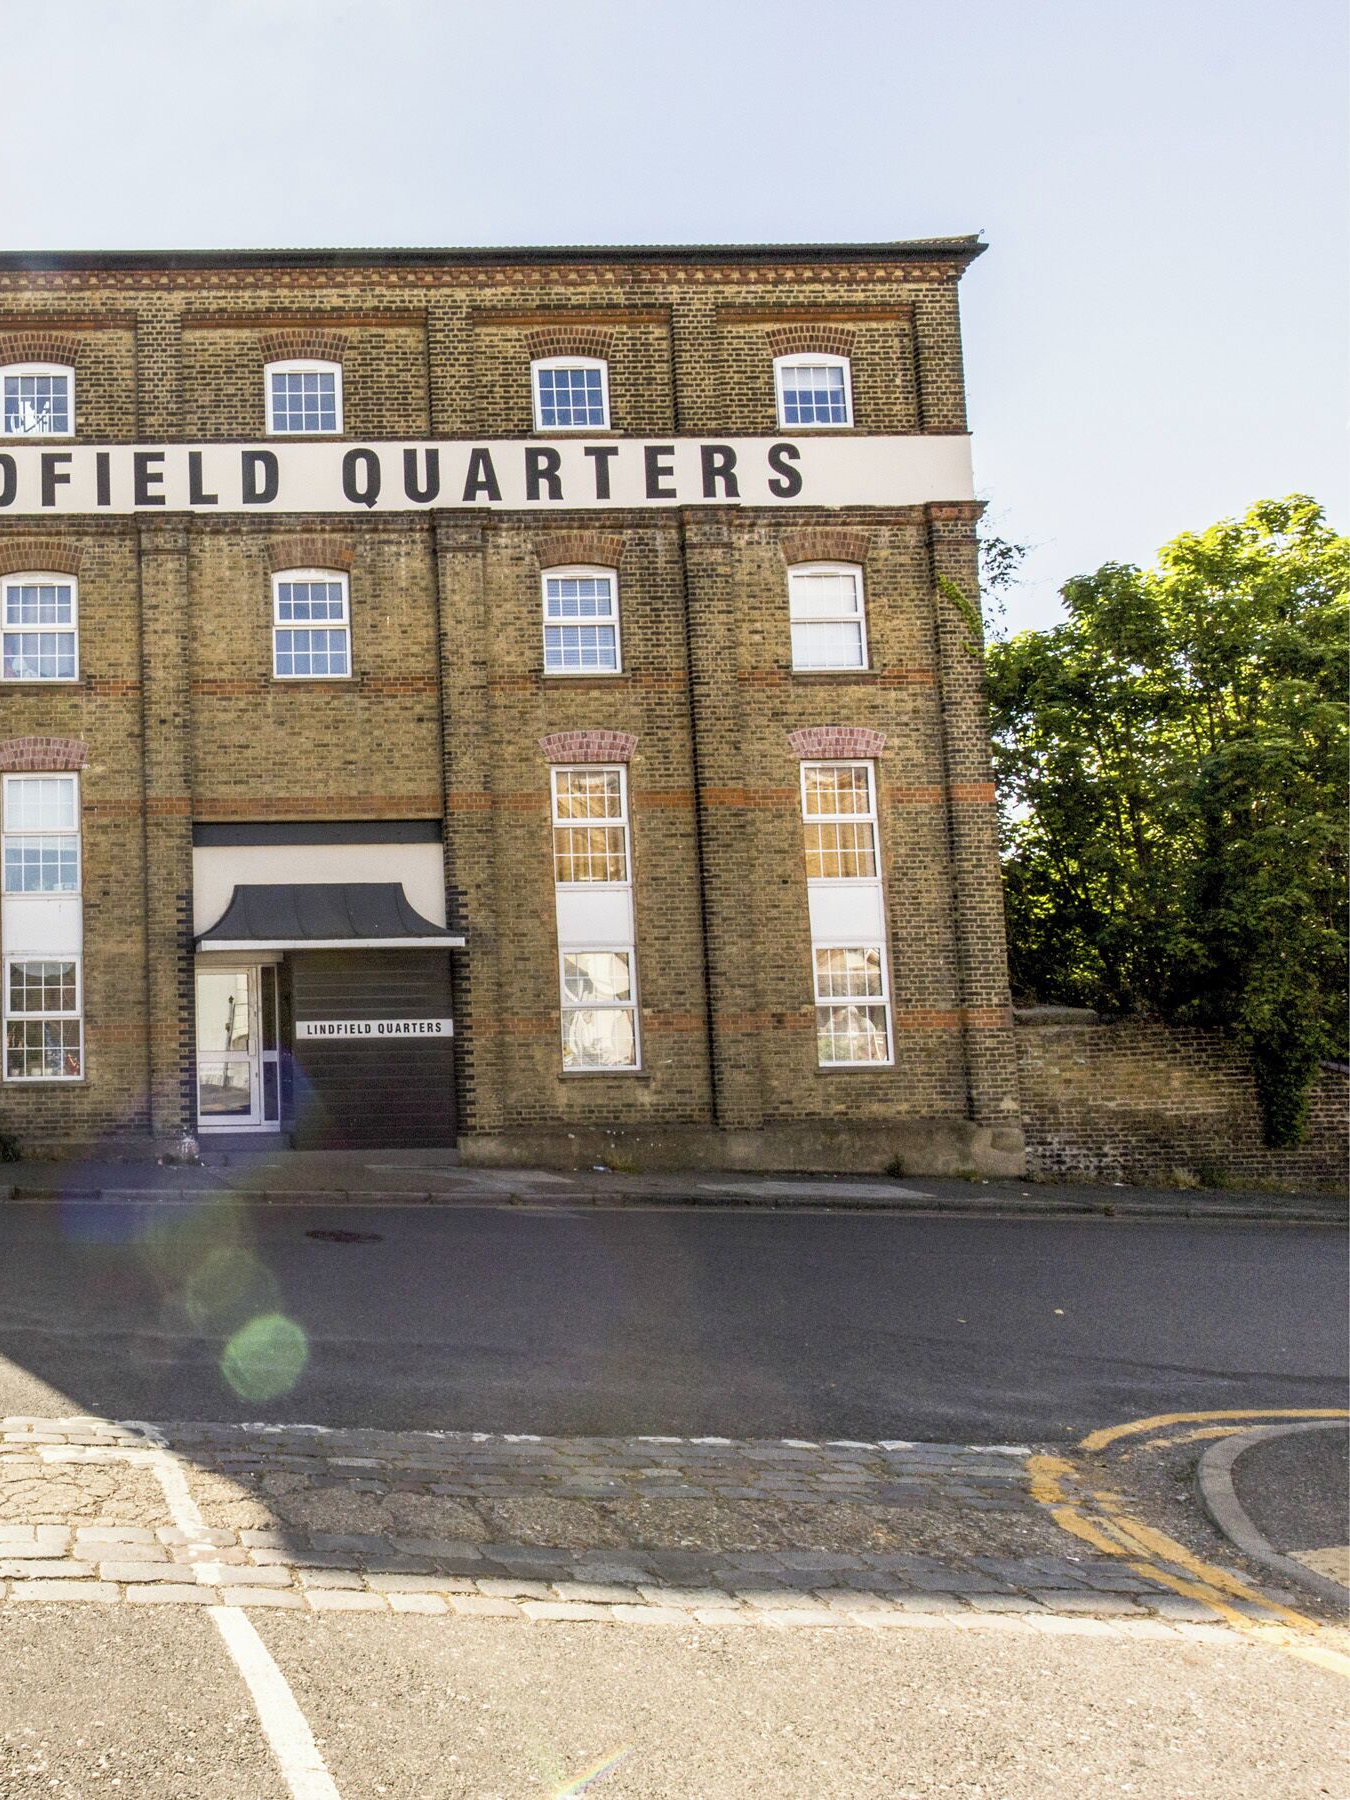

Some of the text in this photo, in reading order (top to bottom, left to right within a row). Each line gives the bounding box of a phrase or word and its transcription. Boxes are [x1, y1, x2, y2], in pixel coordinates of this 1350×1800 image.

[342, 443, 803, 509] QUARTERS
[307, 1022, 442, 1035] LINDFIELD QUARTERS
